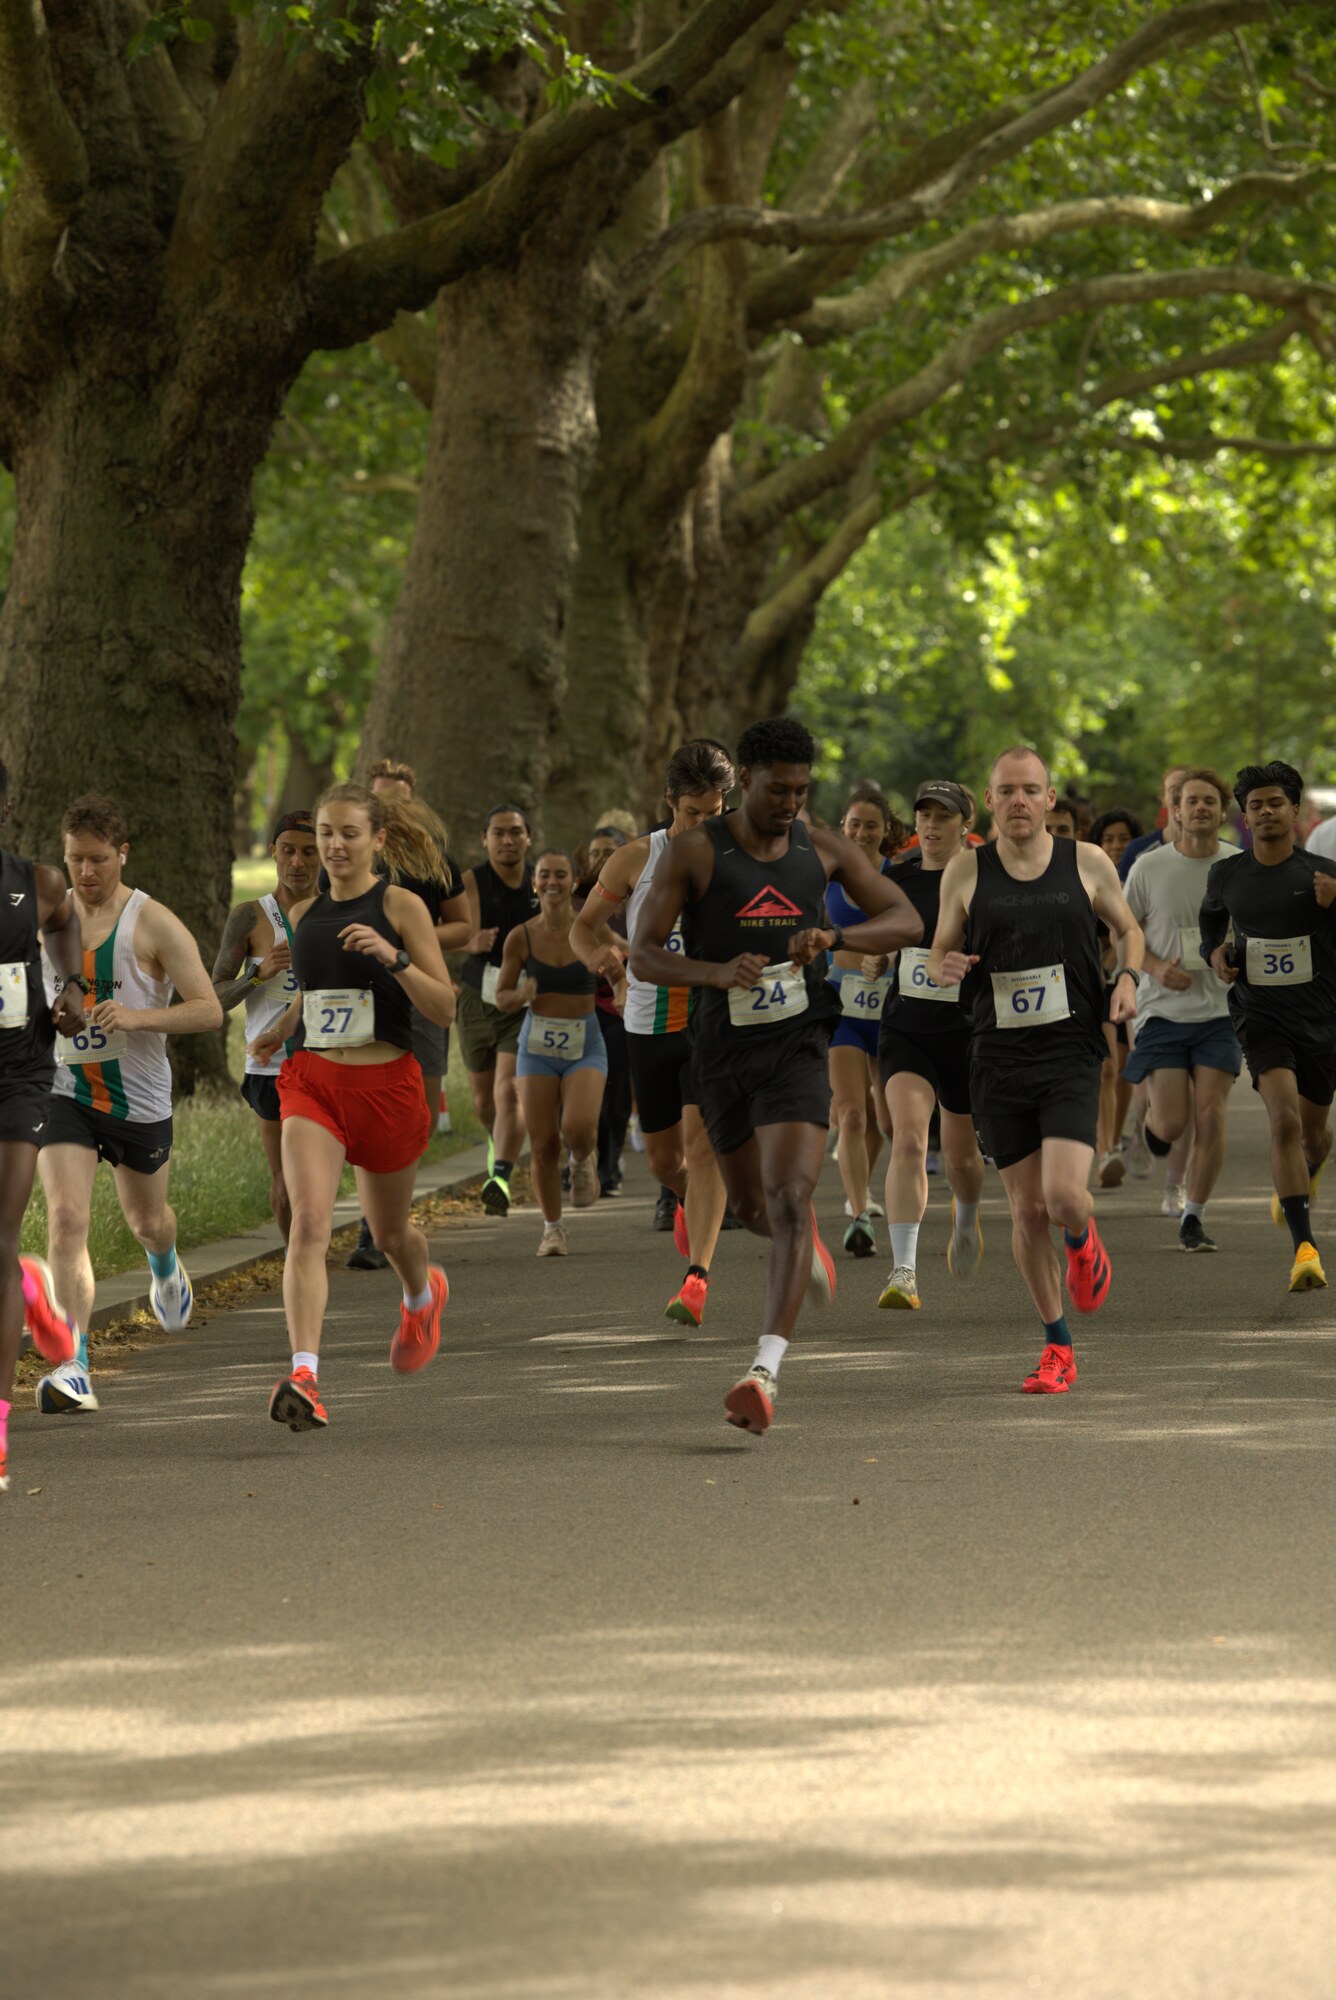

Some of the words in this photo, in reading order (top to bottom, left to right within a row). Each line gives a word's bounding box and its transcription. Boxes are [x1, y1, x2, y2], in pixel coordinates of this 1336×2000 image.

[1037, 891, 1070, 905] MIND
[740, 919, 765, 927] NIKE
[768, 918, 797, 926] TRAIL
[1264, 953, 1294, 974] 36
[750, 981, 787, 1010] 24
[854, 990, 880, 1009] 46
[1012, 986, 1046, 1014] 67
[320, 1008, 353, 1033] 27
[72, 1025, 107, 1050] 65
[543, 1031, 570, 1050] 52
